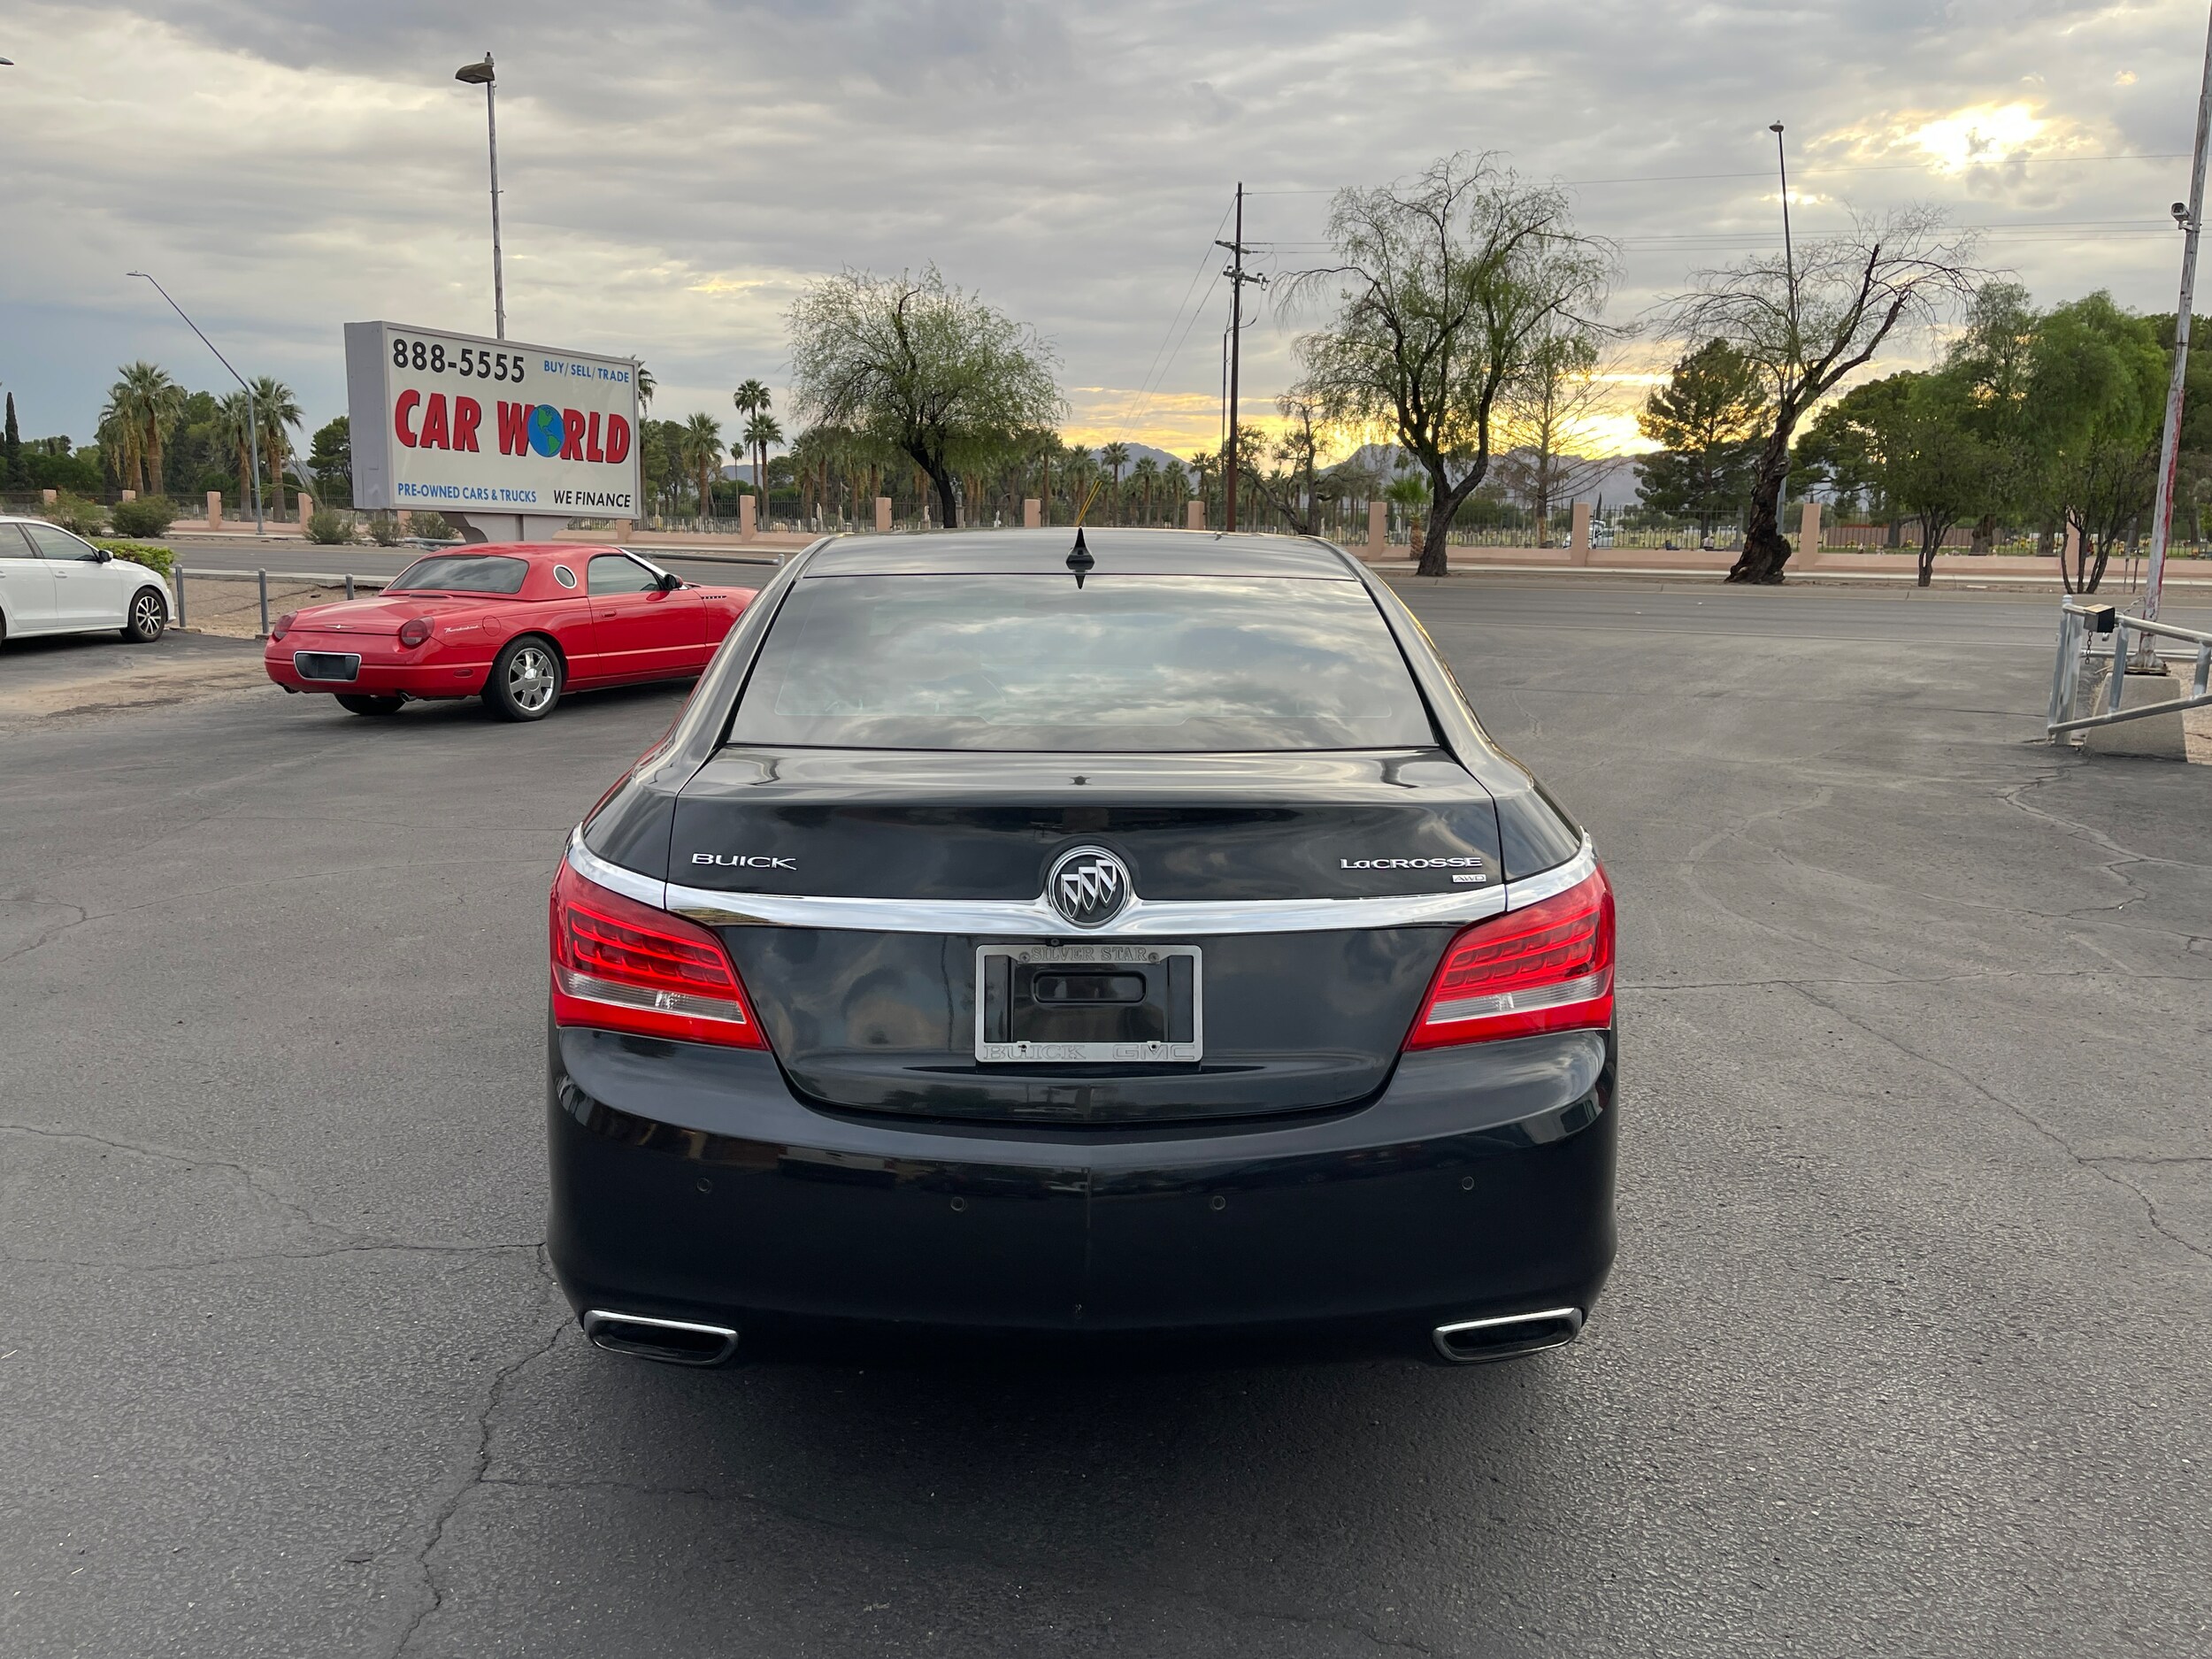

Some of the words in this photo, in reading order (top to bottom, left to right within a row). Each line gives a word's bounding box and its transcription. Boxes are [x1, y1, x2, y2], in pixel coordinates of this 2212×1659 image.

[393, 339, 525, 383] 888-5555
[395, 389, 481, 453] CAR
[398, 483, 460, 499] PRE-OWNED
[463, 487, 489, 501] CARS
[491, 491, 498, 501] &
[500, 488, 537, 503] TRUCKS
[554, 489, 572, 504] WE
[575, 491, 631, 508] FINANCE
[691, 853, 797, 871] BUICK
[1031, 947, 1094, 962] SILVER
[1101, 947, 1148, 962] STAR
[983, 1044, 1087, 1061] BUICK
[1112, 1044, 1195, 1061] GMC
